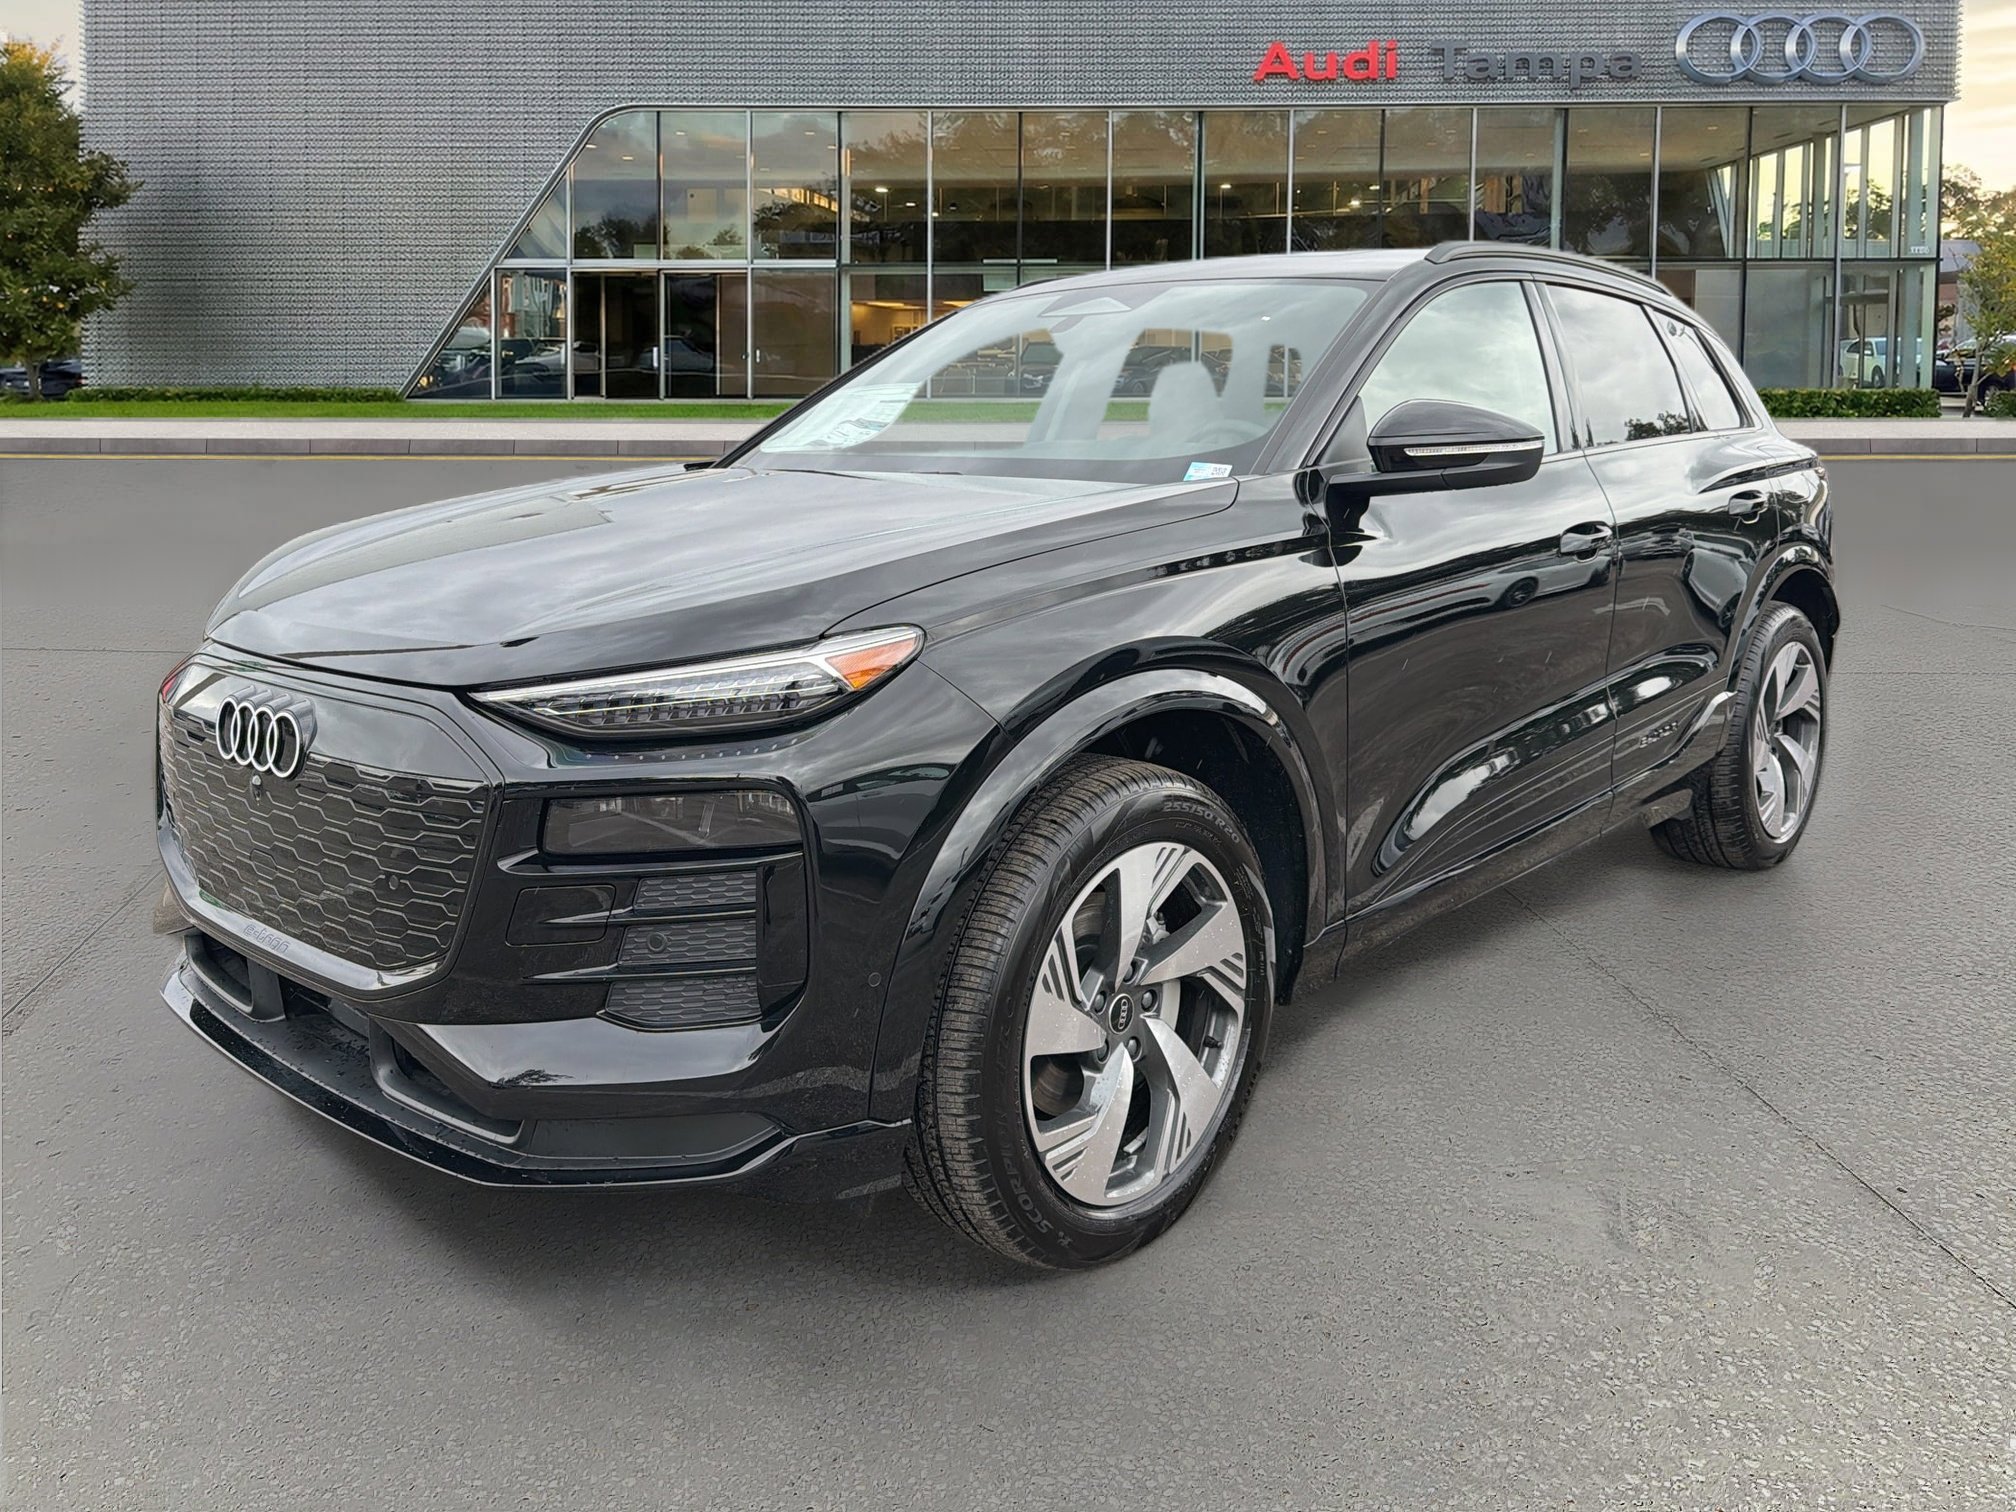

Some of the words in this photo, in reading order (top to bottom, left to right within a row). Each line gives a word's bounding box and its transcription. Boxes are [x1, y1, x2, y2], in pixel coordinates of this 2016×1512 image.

[1253, 39, 1397, 81] Audi
[1430, 39, 1642, 89] Tampa
[243, 924, 291, 953] e-tron
